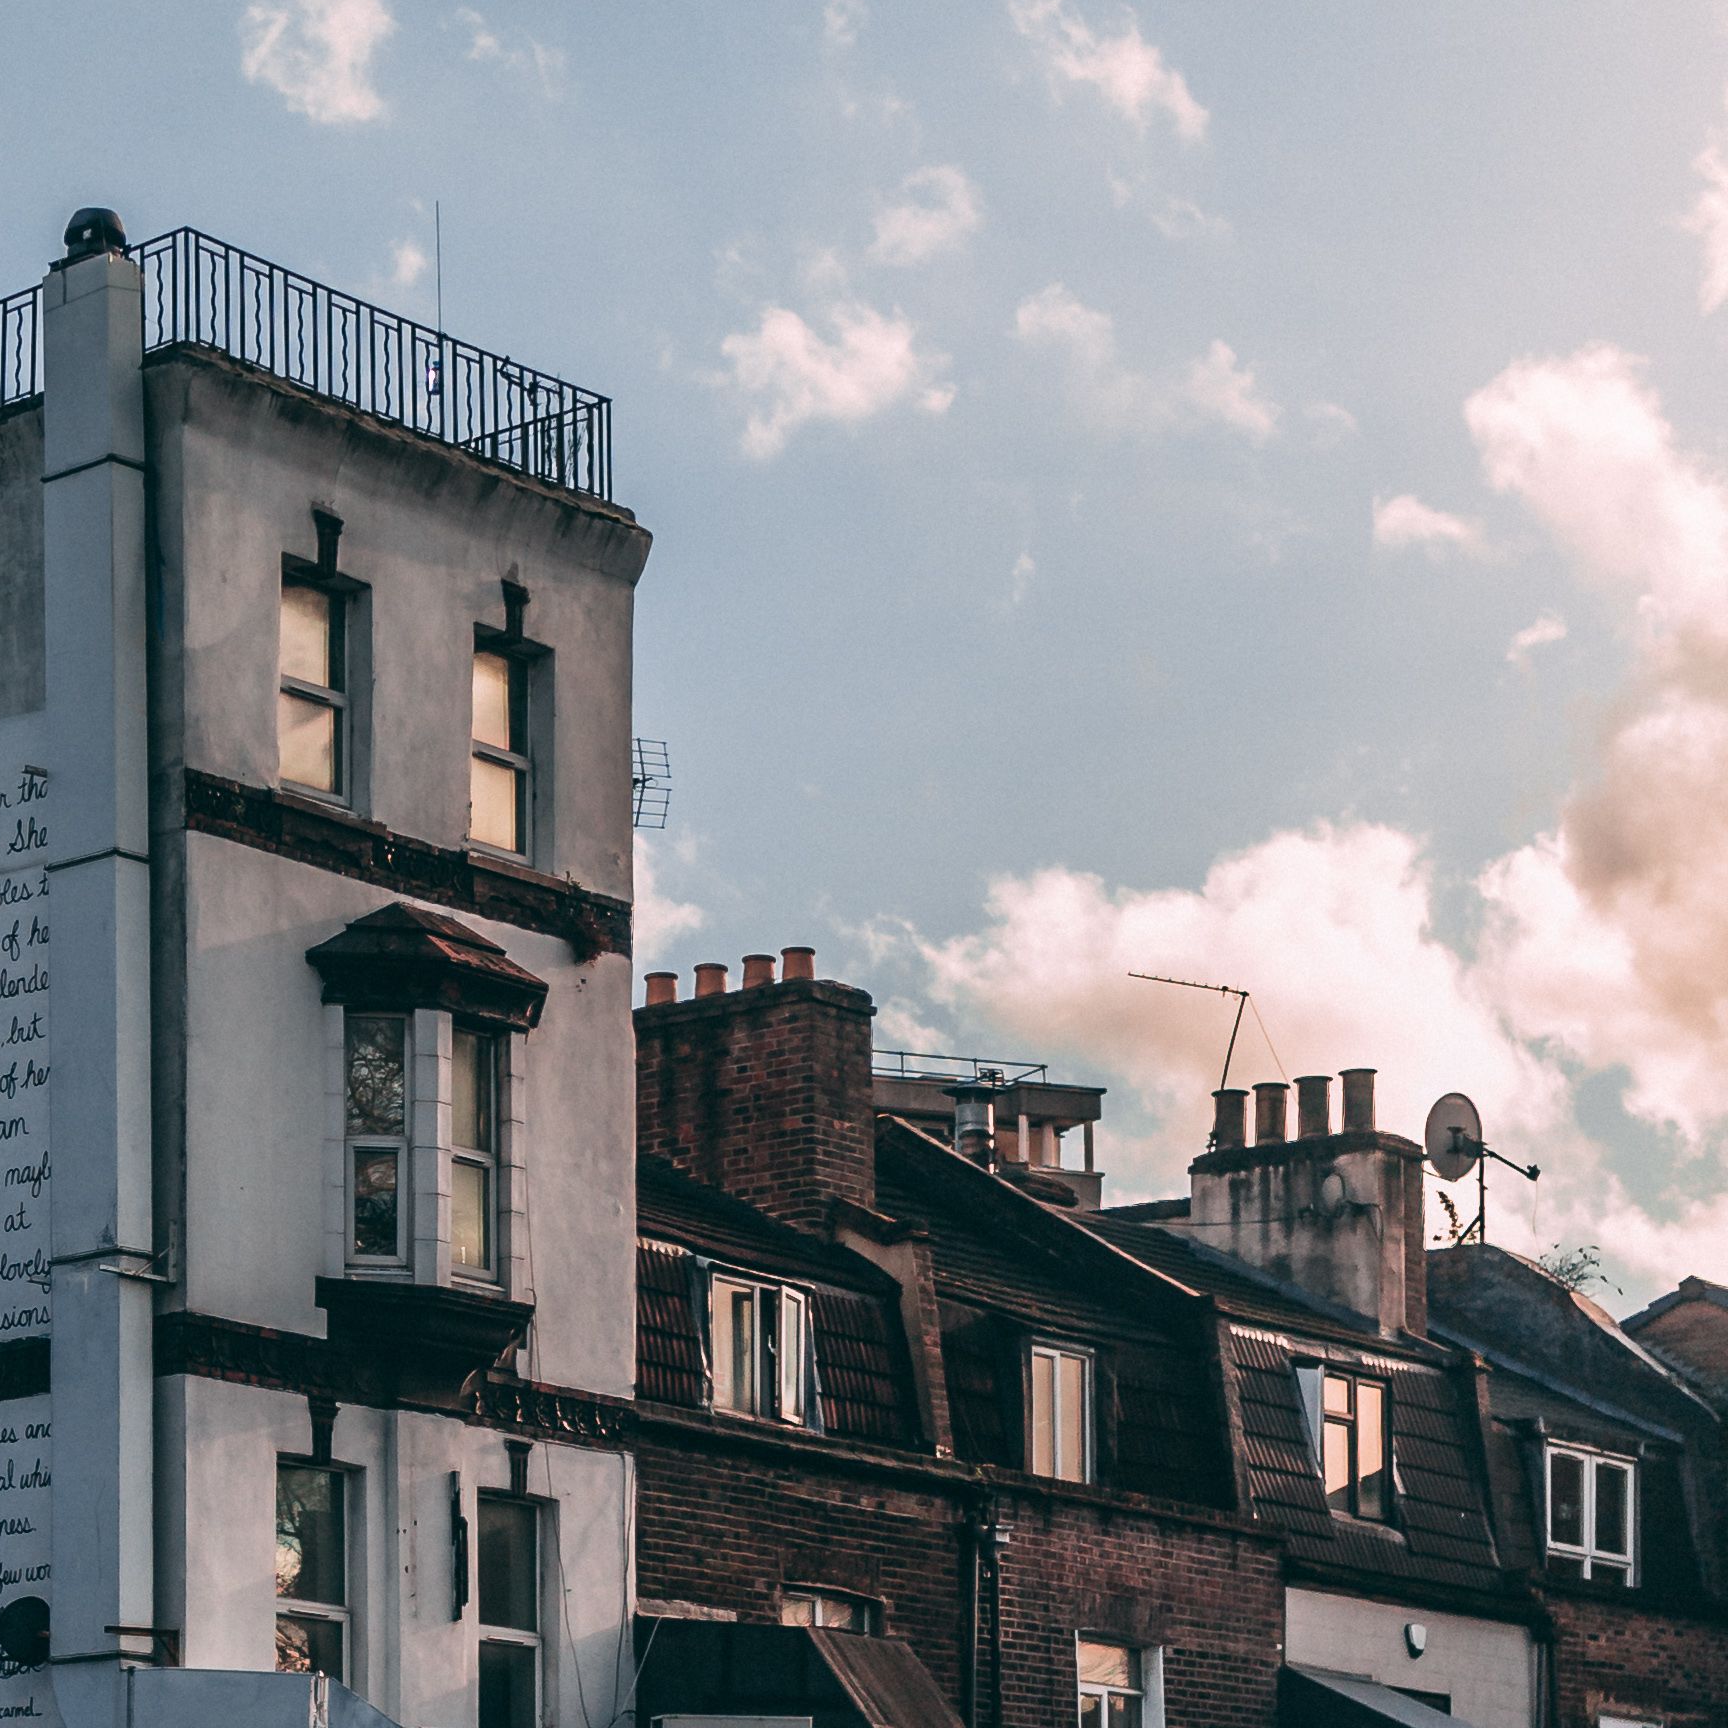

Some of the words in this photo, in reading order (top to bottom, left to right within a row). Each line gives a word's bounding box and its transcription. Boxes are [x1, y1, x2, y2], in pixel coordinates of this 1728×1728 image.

[7, 817, 47, 855] She
[2, 920, 20, 961] of
[7, 1012, 46, 1044] but
[0, 1062, 17, 1099] of
[4, 1208, 32, 1232] at
[0, 1248, 51, 1293] lovely
